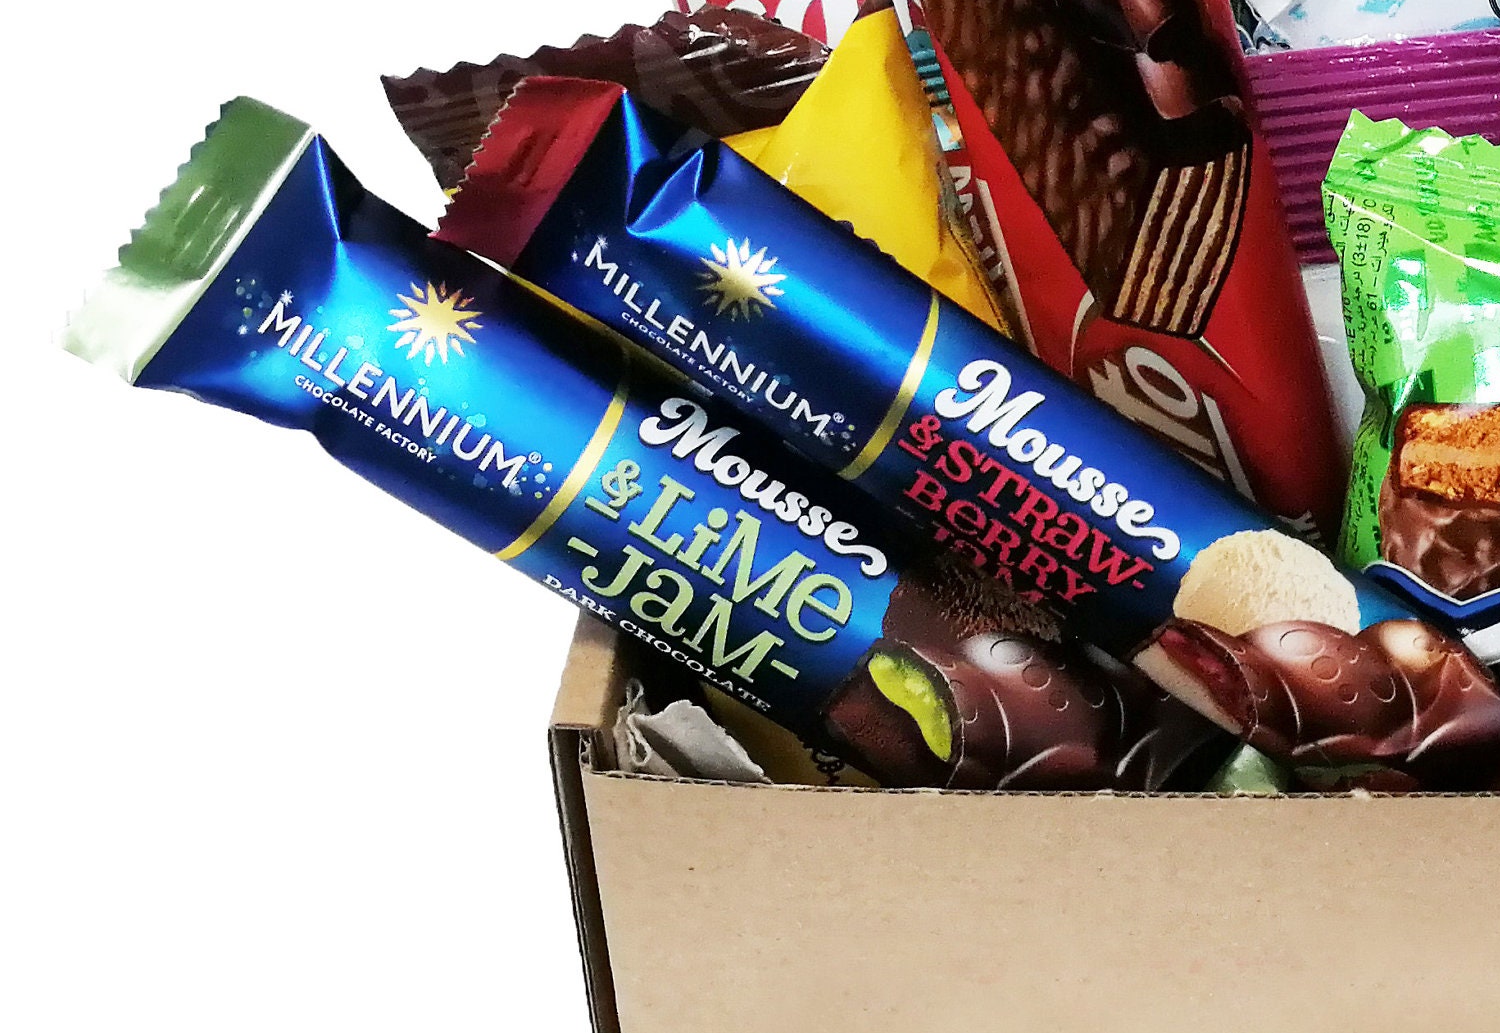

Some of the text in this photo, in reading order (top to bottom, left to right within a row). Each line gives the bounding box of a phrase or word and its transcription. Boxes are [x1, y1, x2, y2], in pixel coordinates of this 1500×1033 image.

[621, 311, 756, 404] CHOCOLATE FACTORY
[293, 374, 438, 465] CHOCOLATE FACTORY
[905, 414, 944, 454] &
[934, 359, 1181, 561] Mousse
[598, 459, 644, 510] &
[639, 397, 888, 577] Mousse
[542, 574, 772, 713] DARK CHOCOLATE
